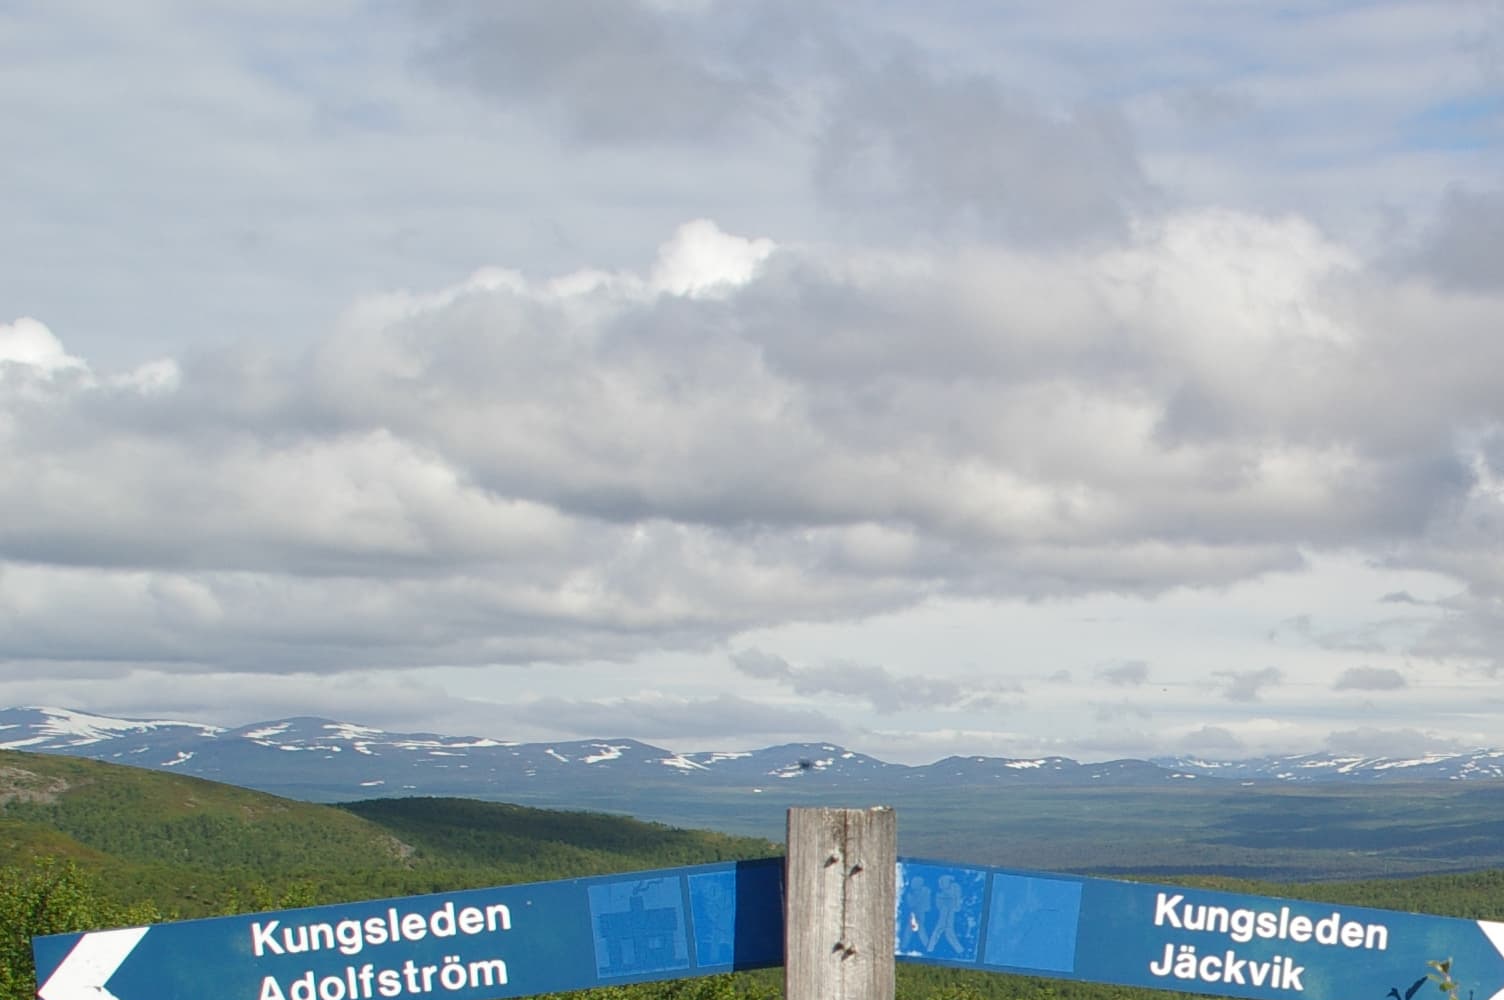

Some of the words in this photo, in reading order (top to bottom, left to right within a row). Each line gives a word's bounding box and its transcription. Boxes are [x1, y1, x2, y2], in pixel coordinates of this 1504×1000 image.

[251, 901, 511, 957] Kungsleden
[1154, 892, 1388, 950] Kungsleden
[1149, 943, 1305, 991] Jäckvik
